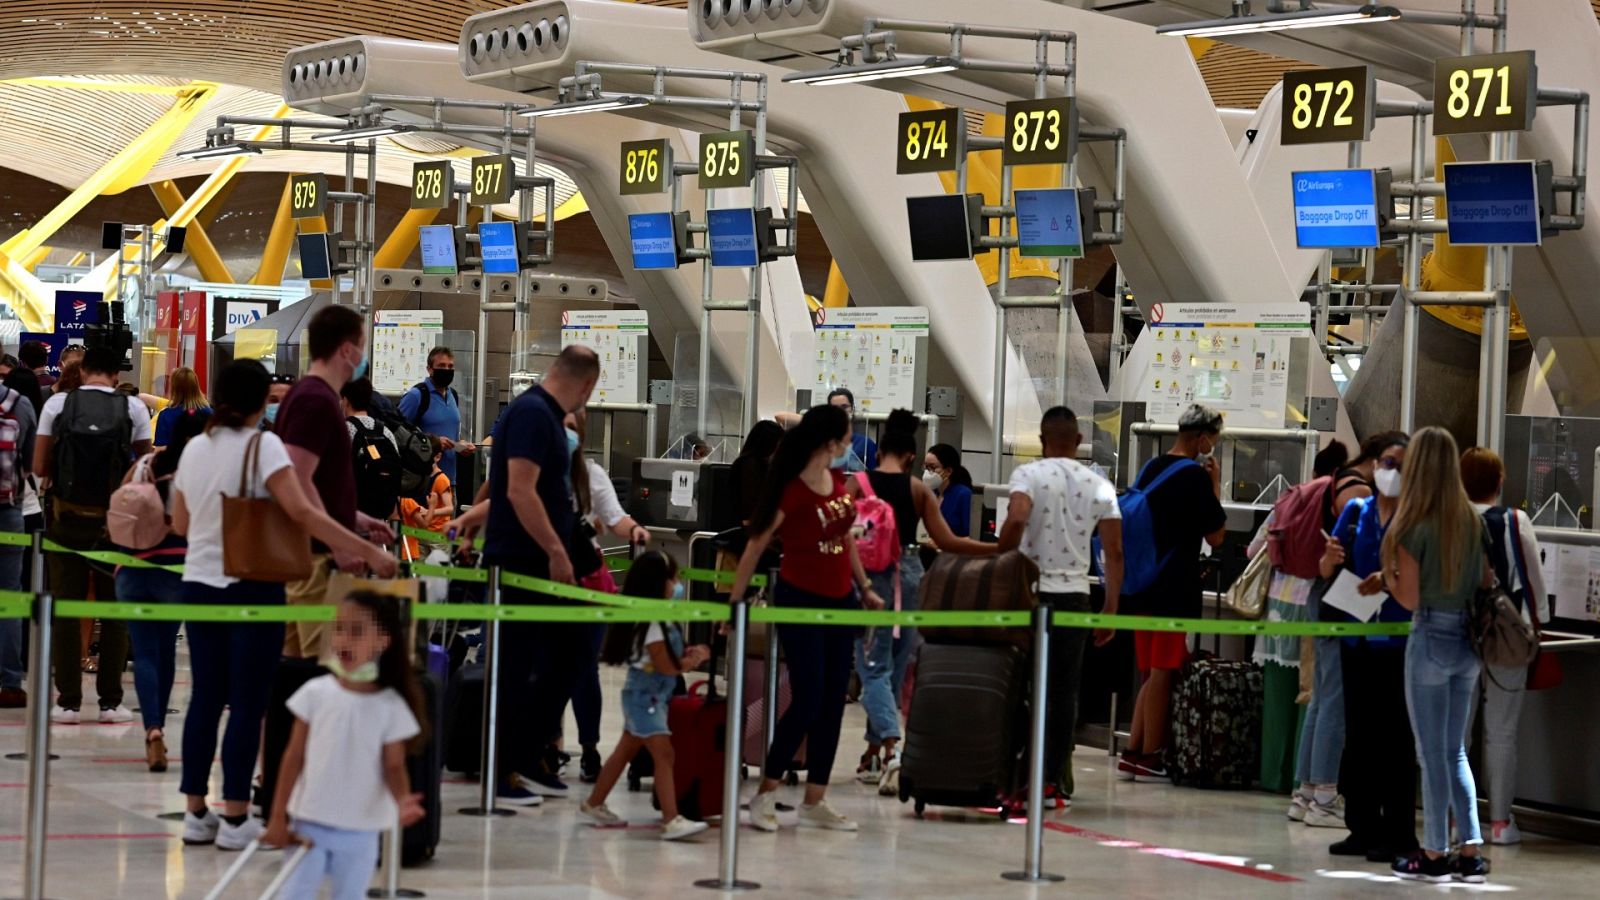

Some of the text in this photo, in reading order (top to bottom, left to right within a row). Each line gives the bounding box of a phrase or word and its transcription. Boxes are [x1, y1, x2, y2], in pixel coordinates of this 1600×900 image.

[1292, 79, 1354, 130] 872
[1447, 65, 1512, 119] 871
[906, 119, 948, 161] 874
[1012, 109, 1060, 152] 873
[626, 149, 658, 183] 876
[705, 141, 740, 177] 875
[294, 181, 316, 209] 879
[416, 169, 442, 199] 878
[475, 163, 502, 196] 877
[1299, 209, 1368, 224] Baggage Drop Off
[1452, 204, 1528, 219] Baggage Drop Off
[60, 322, 85, 330] LATA
[158, 308, 164, 320] IB
[183, 309, 190, 321] IB
